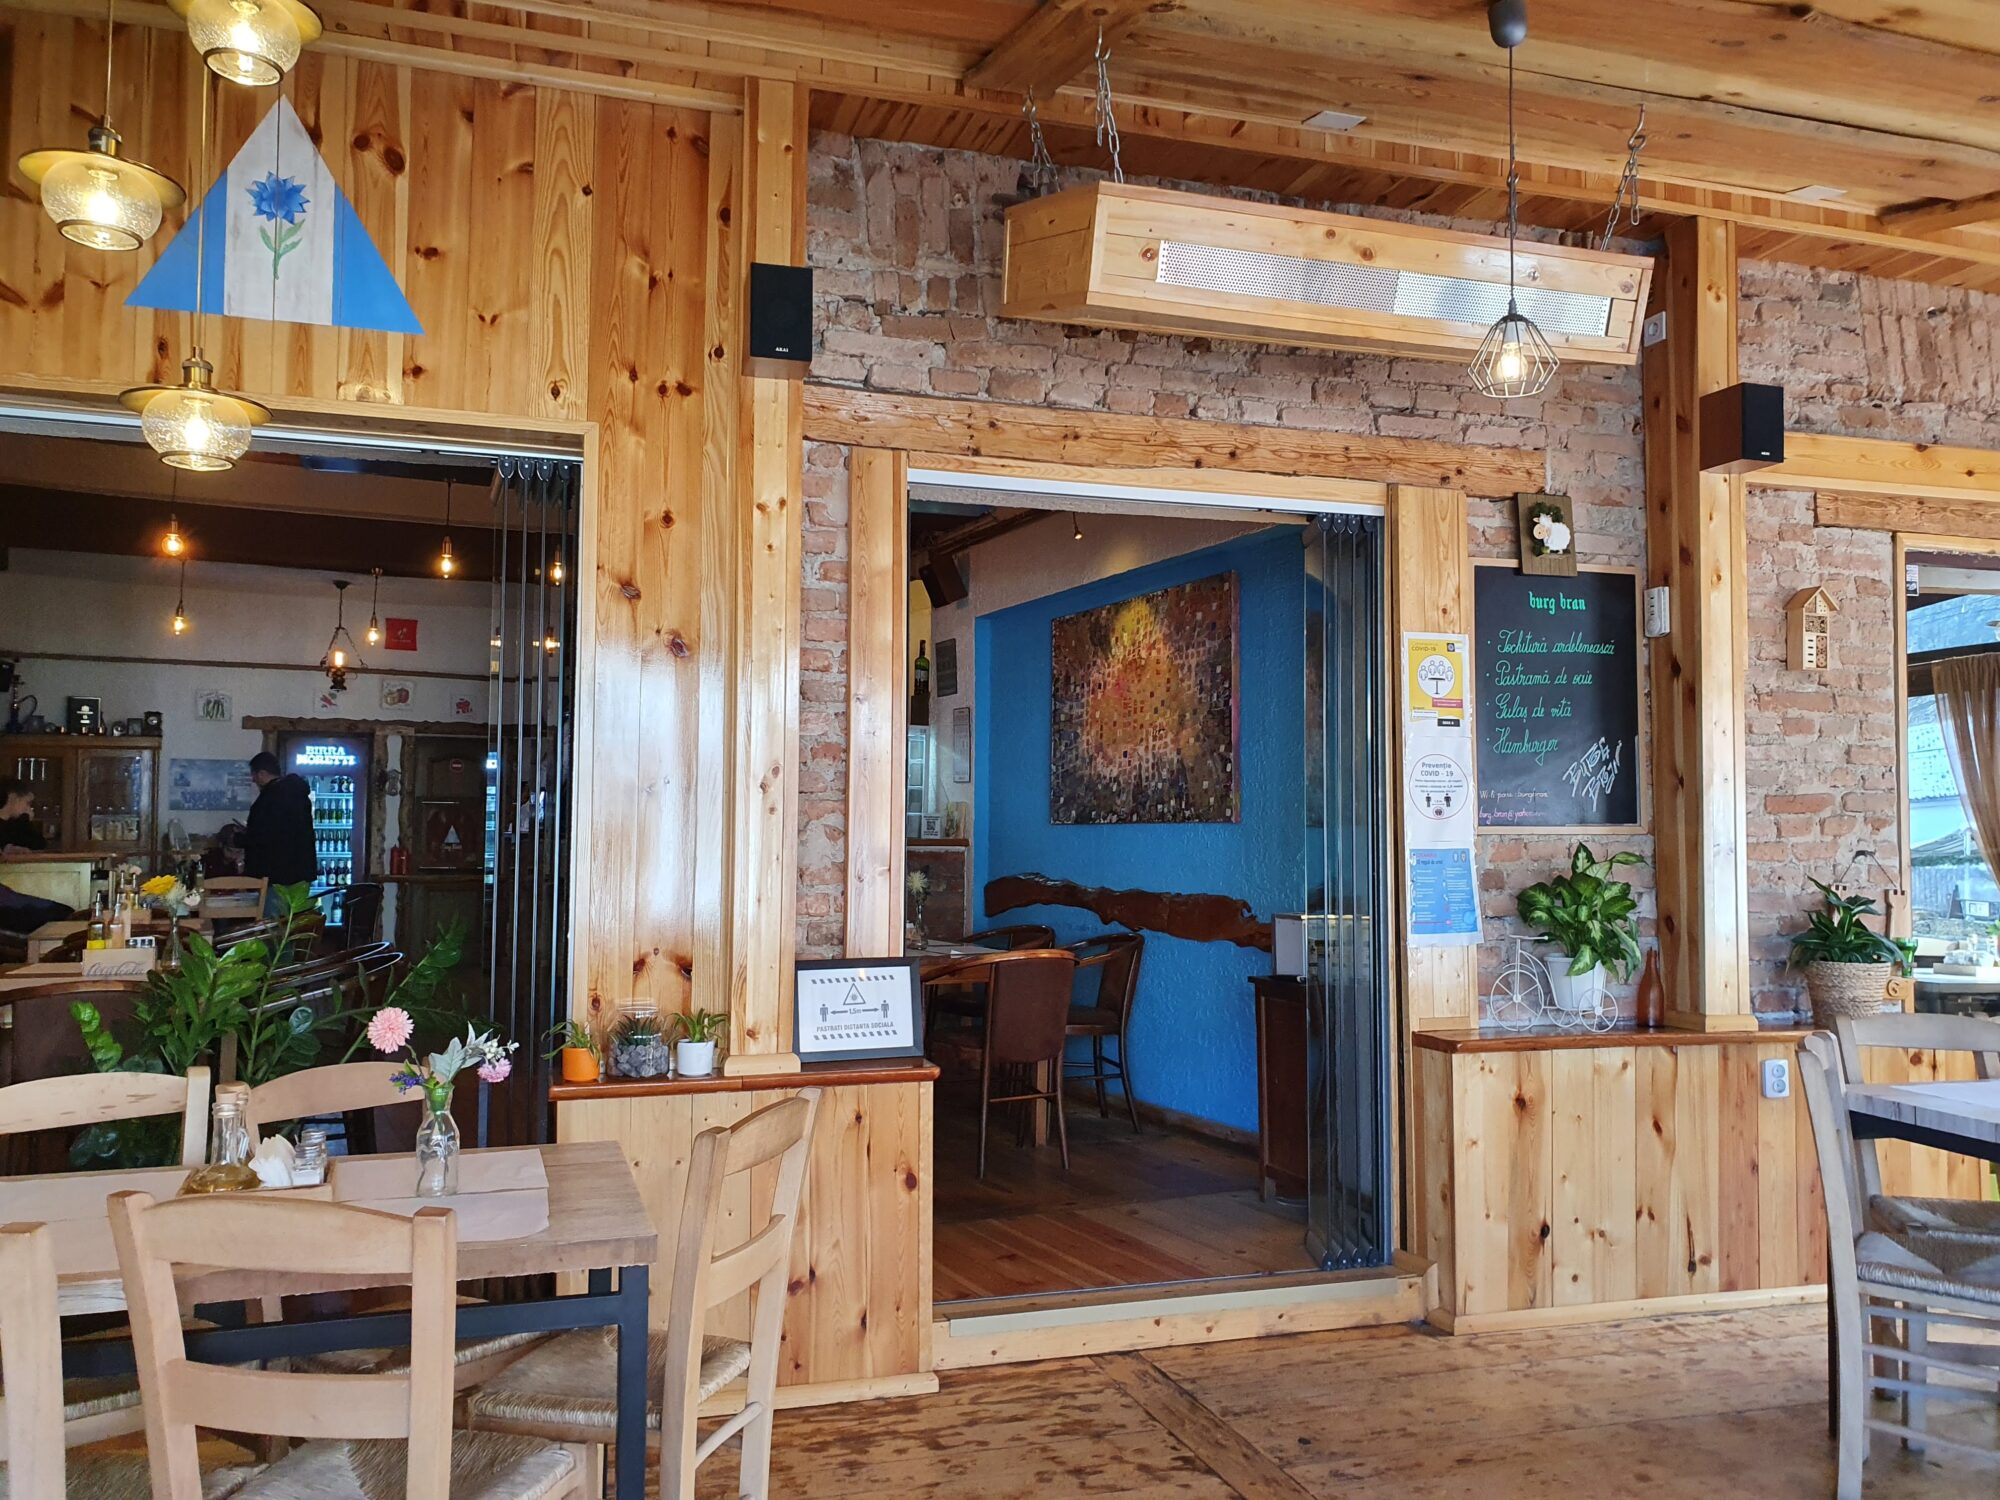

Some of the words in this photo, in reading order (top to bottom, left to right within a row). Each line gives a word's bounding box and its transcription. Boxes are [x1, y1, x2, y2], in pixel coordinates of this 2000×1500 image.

[1528, 590, 1556, 615] burg
[1559, 591, 1586, 611] bran
[1553, 667, 1568, 686] de
[1531, 696, 1545, 718] de
[305, 745, 346, 756] BIRRA
[1492, 726, 1560, 767] Hamburger
